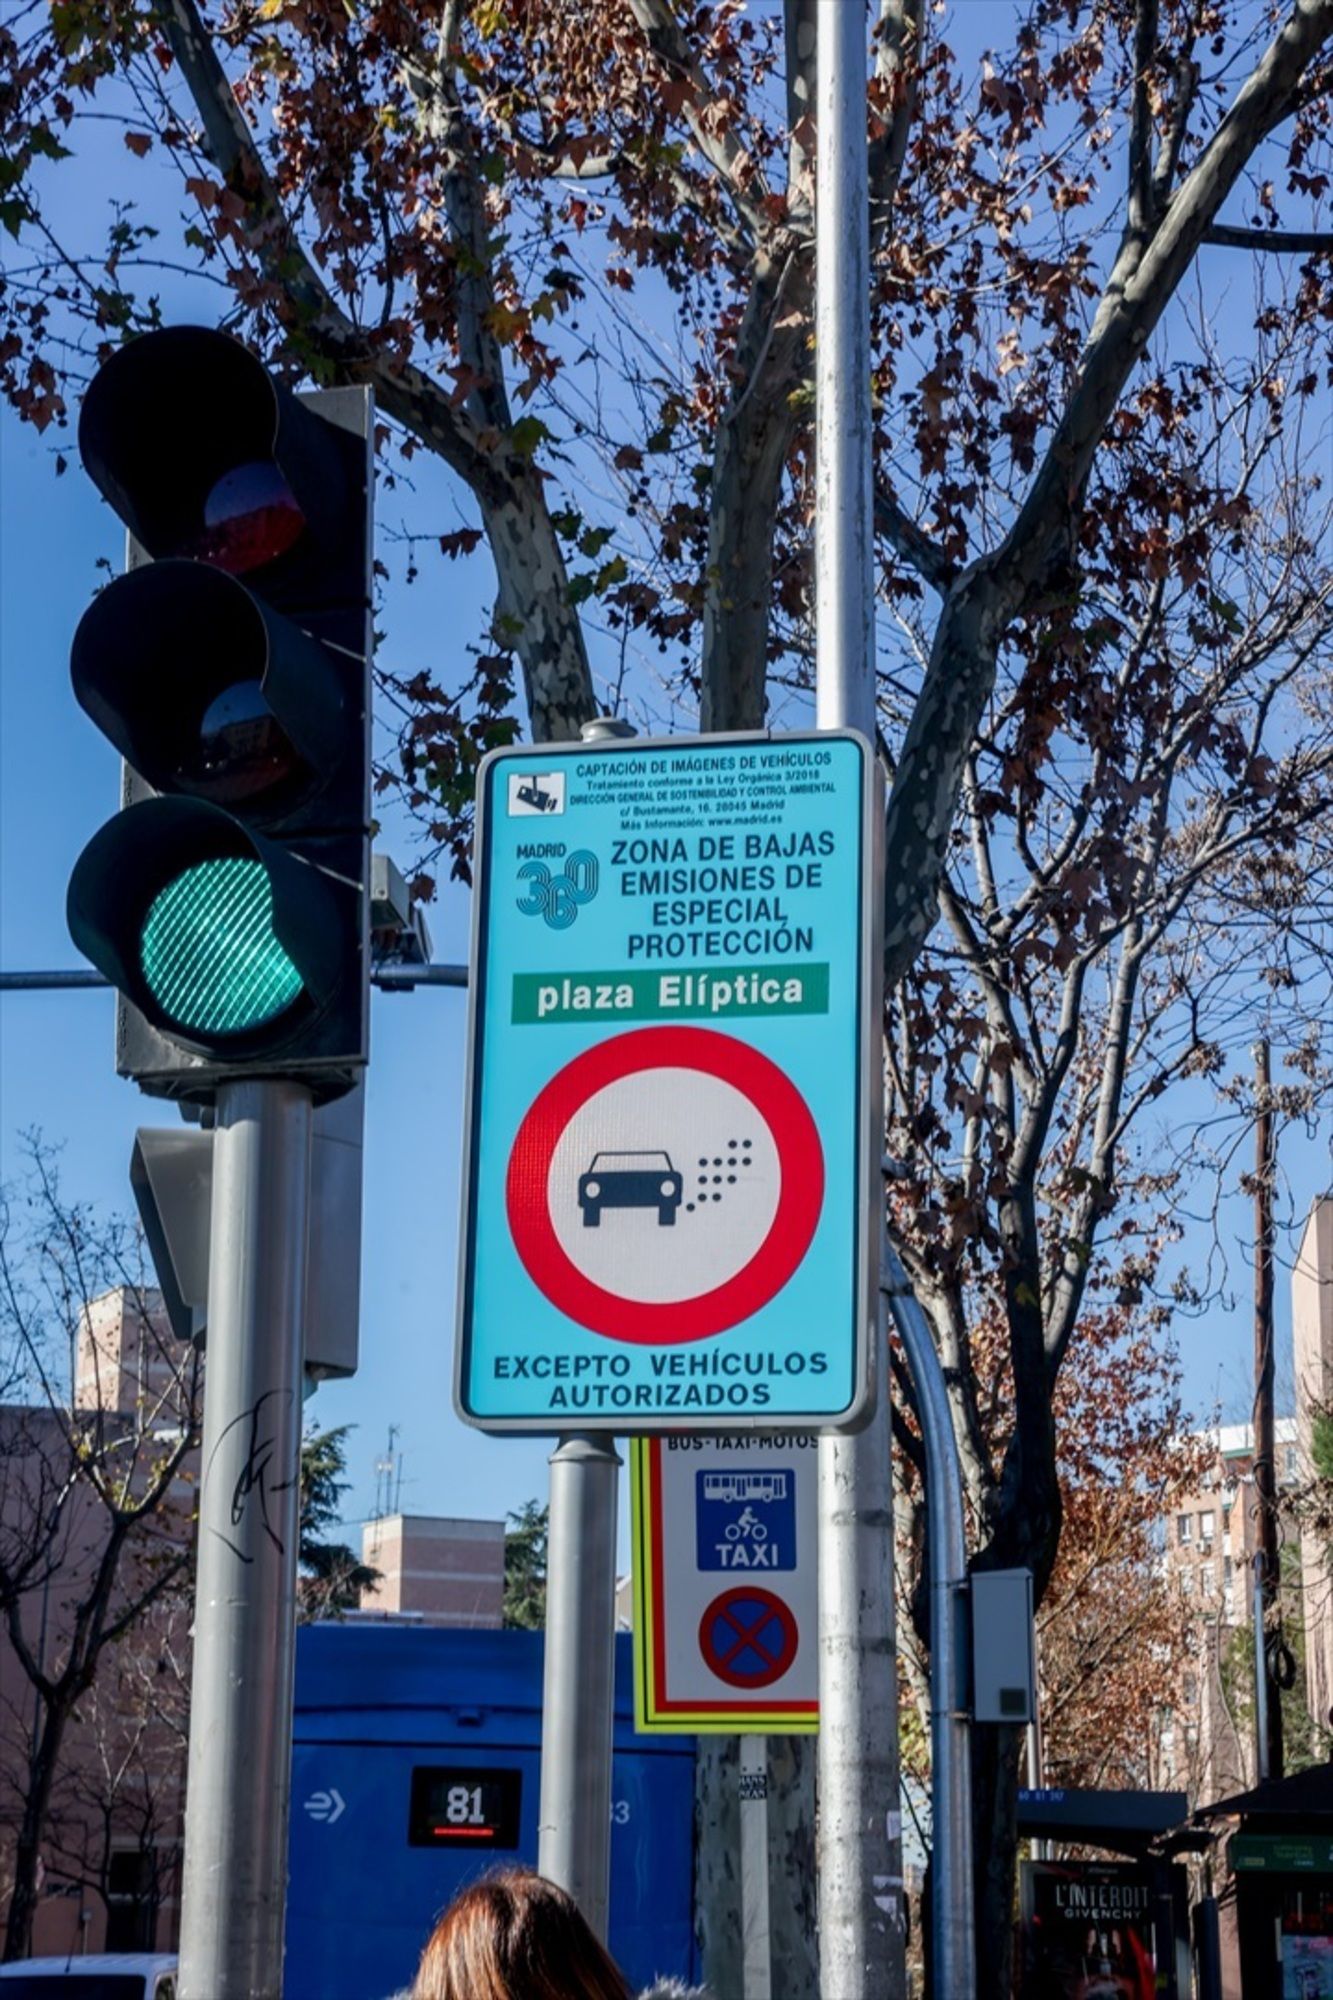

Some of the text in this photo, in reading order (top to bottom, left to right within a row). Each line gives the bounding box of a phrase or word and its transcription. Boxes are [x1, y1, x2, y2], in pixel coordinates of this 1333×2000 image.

[576, 751, 831, 777] CAPTACIÓN DE IMÁGENES DE VEHÍCULOS
[587, 770, 820, 790] Tratamiento conforme a la Ley Orgánica 3/2018
[569, 782, 836, 806] DIRECCIÓN GENERAL DE SOSTENIBILIDAD Y CONTROL AMBIENTAL
[620, 806, 631, 817] c/
[716, 801, 746, 812] 28045
[751, 799, 785, 810] Madrid
[621, 820, 641, 830] Más
[708, 814, 783, 826] www.madrid.es
[516, 843, 567, 859] MADRID
[610, 831, 835, 865] ZONA DE BAJAS
[516, 849, 599, 930] 360
[621, 863, 822, 896] EMISIONES DE
[653, 897, 788, 926] ESPECIAL
[628, 922, 813, 959] PROTECCIÓN
[538, 973, 803, 1017] plaza Elíptica
[494, 1348, 828, 1379] EXCEPTO VEHÍCULOS
[549, 1383, 771, 1408] AUTORIZADOS
[715, 1544, 778, 1567] TAXI
[447, 1786, 485, 1823] 81
[1064, 1909, 1141, 1919] GIVENCHY
